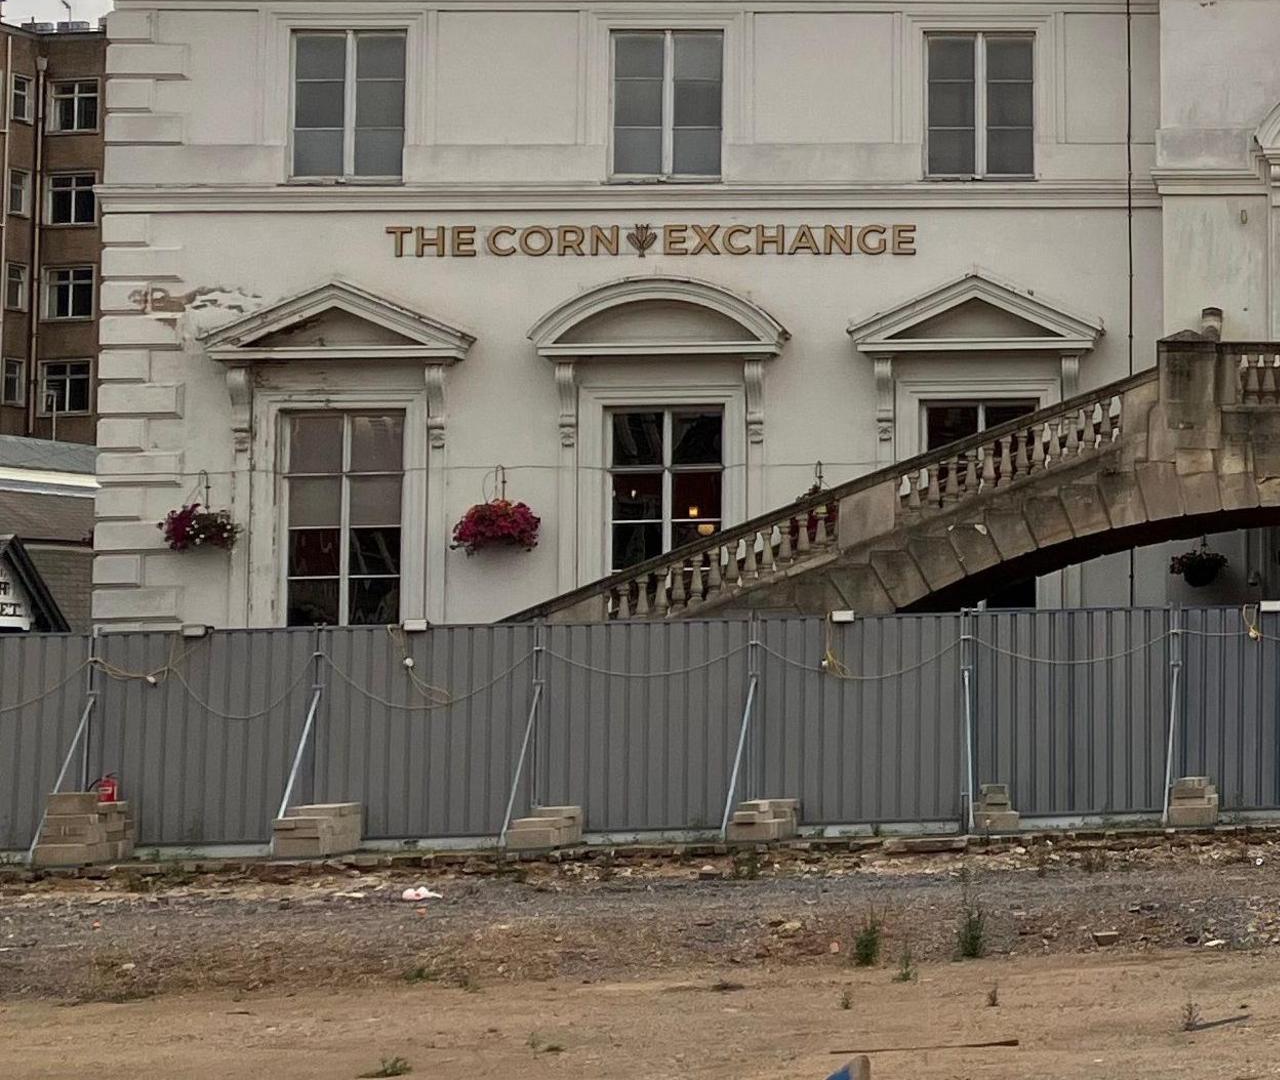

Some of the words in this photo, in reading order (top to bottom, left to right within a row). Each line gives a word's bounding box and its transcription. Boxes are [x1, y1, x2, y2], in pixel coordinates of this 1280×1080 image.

[385, 225, 476, 258] THE
[486, 225, 620, 257] CORN
[663, 224, 917, 256] EXCHANGE
